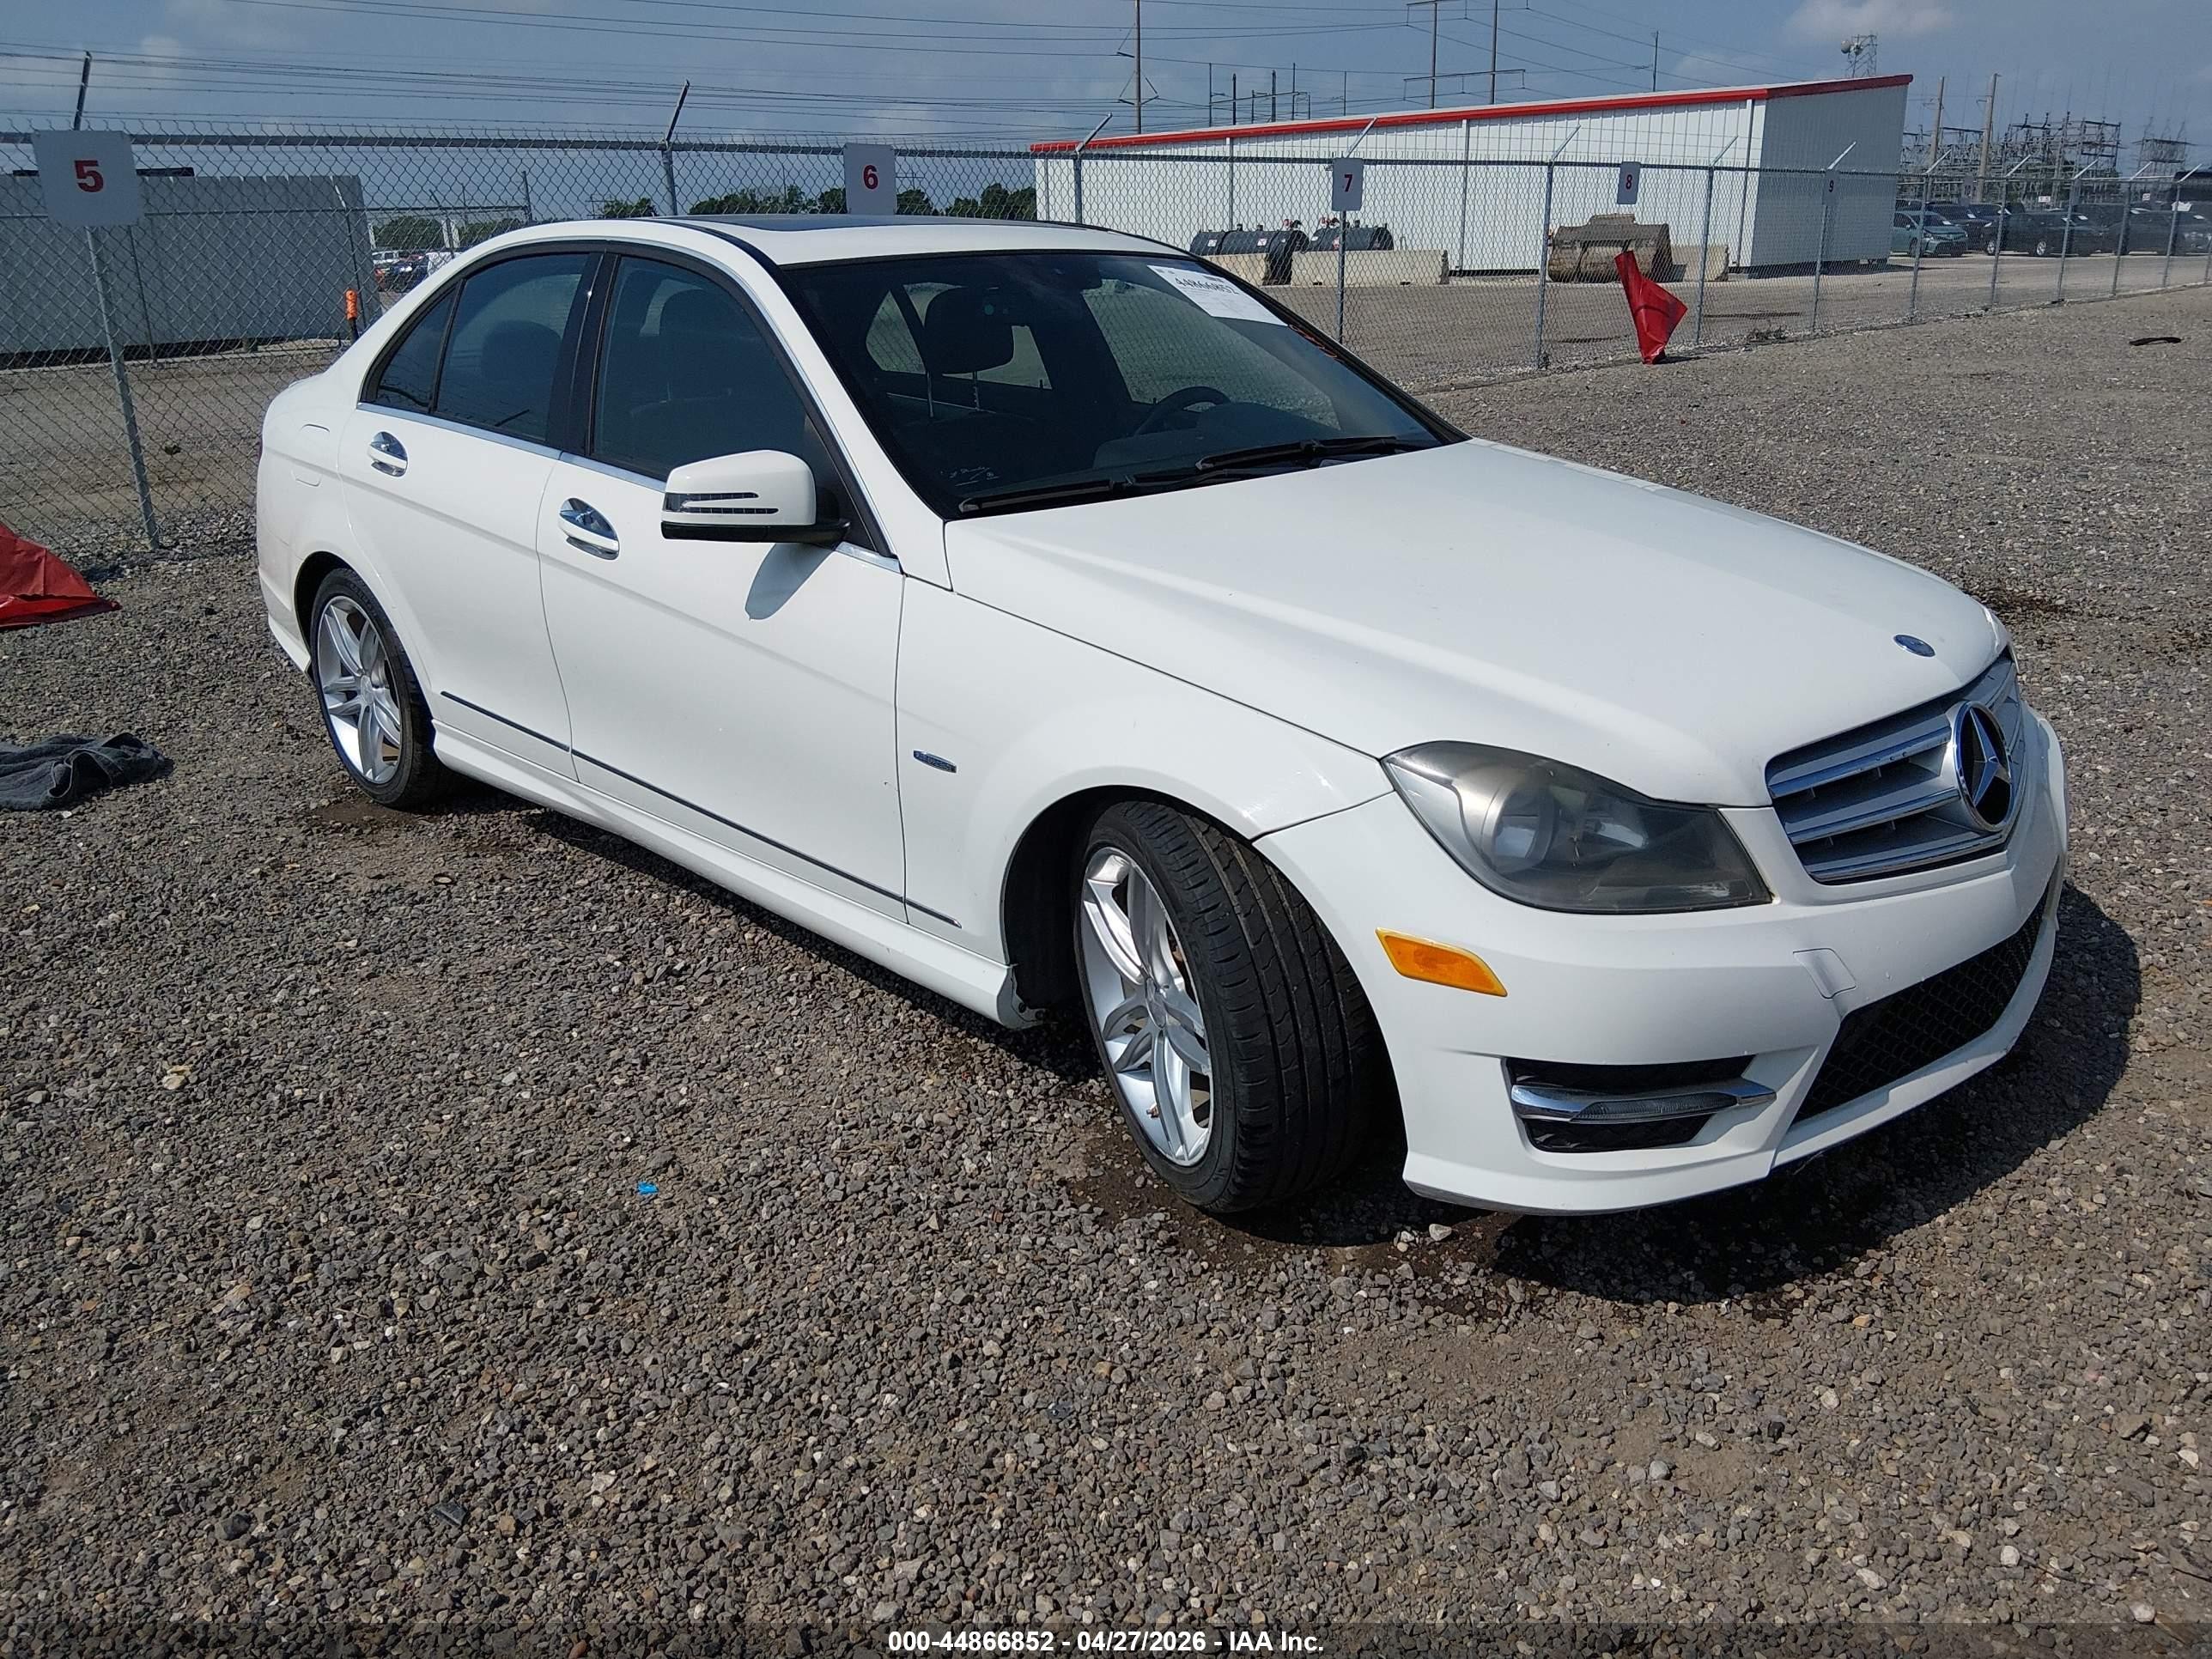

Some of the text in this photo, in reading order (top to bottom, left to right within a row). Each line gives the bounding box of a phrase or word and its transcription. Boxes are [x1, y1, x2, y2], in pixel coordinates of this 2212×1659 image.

[74, 160, 104, 192] 5
[863, 164, 878, 190] 6
[1344, 173, 1353, 192] 7
[1626, 174, 1633, 190] 8
[1828, 179, 1834, 192] 9
